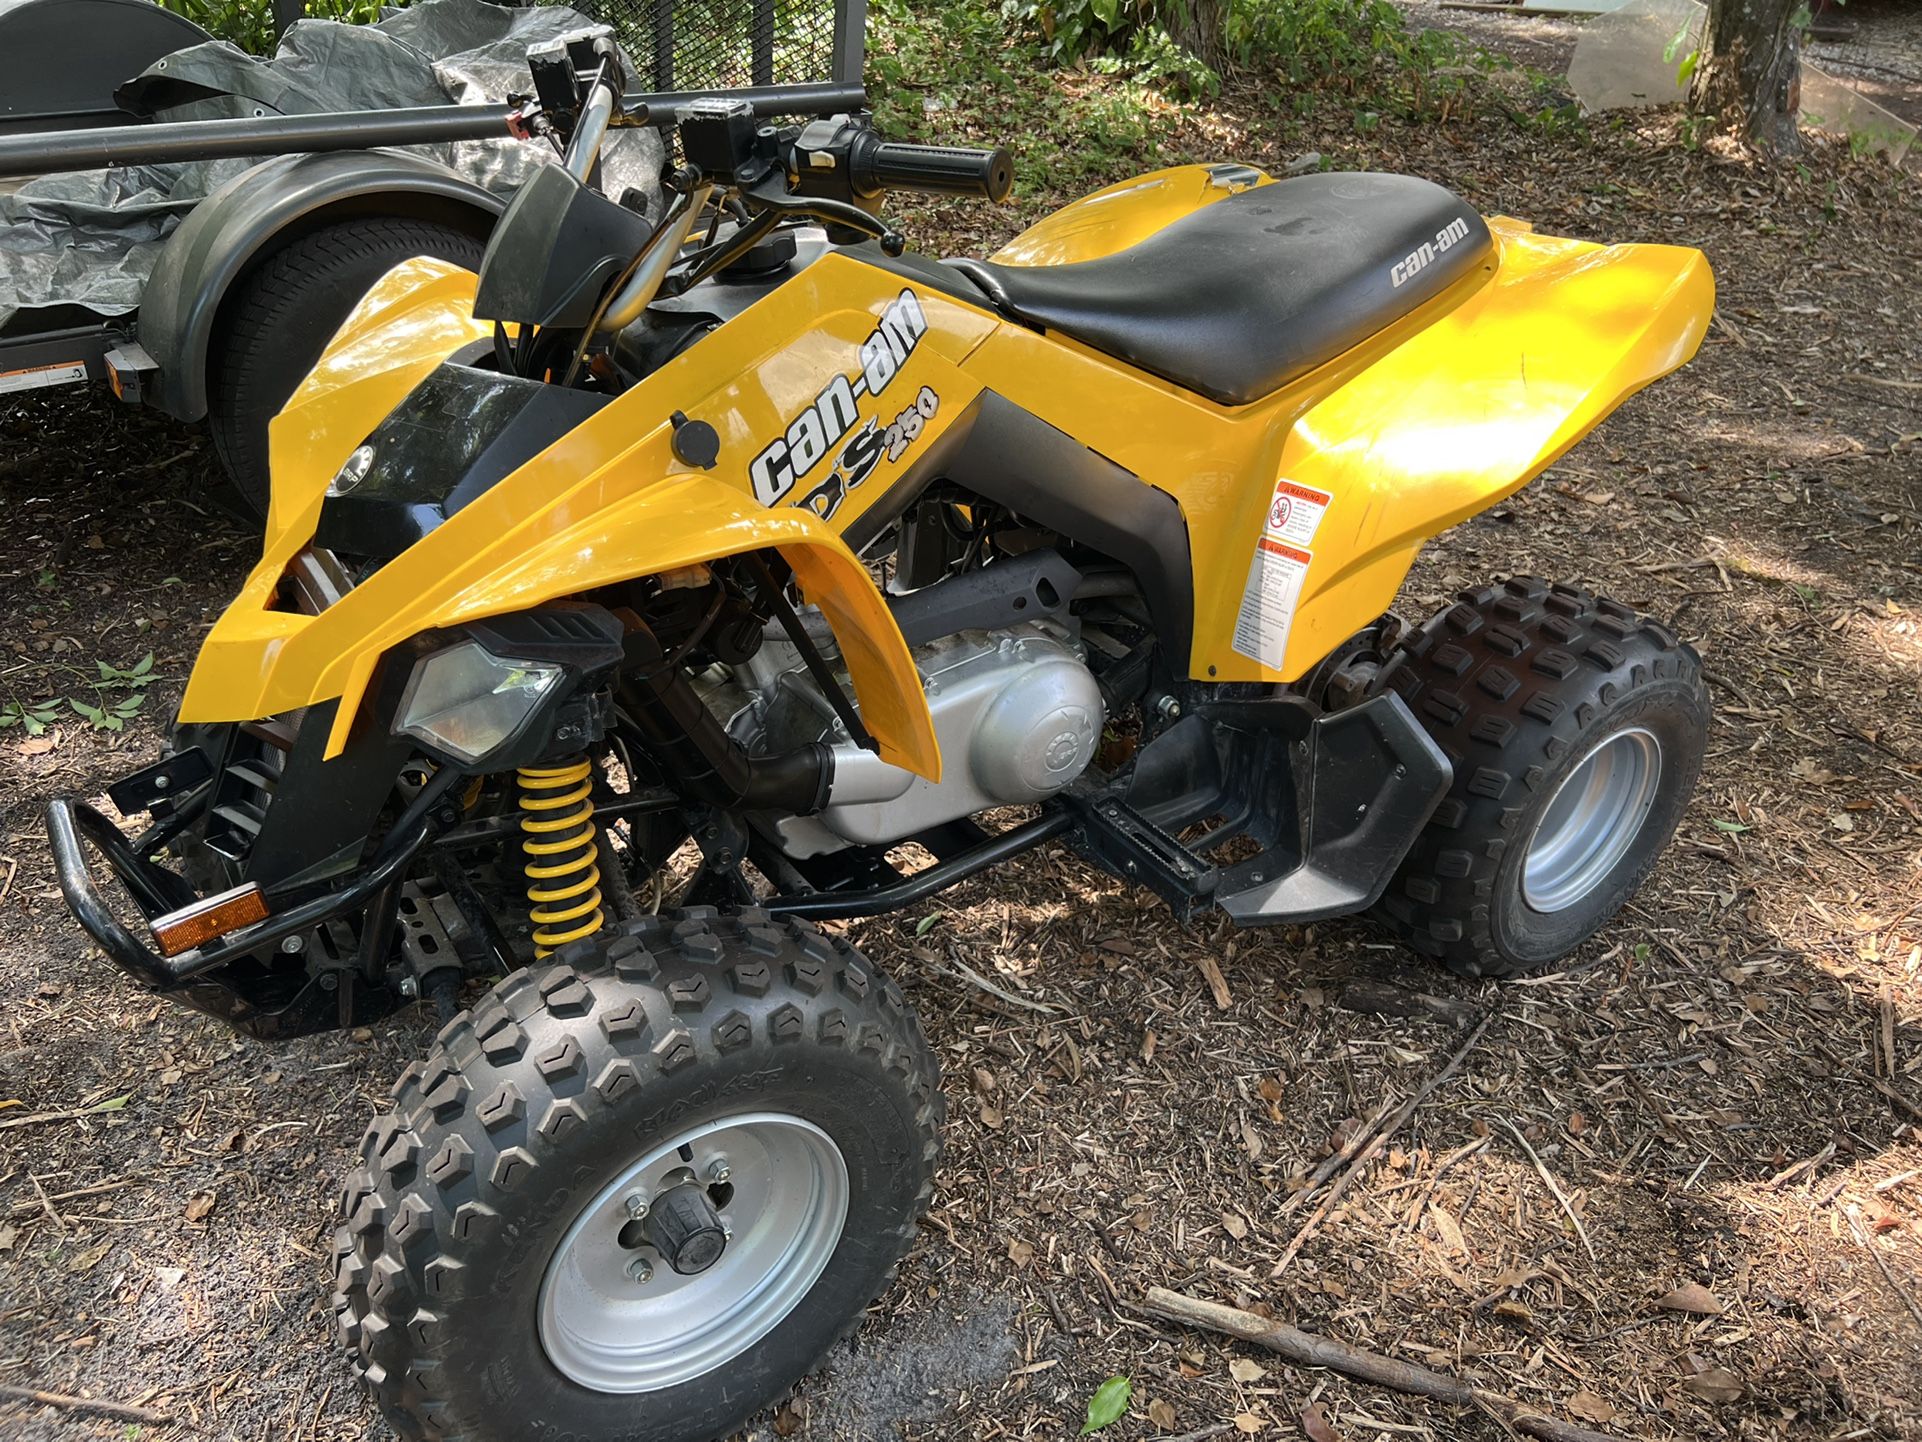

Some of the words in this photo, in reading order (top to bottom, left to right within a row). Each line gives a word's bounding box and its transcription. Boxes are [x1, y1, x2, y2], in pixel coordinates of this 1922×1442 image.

[1390, 217, 1469, 288] can-am
[750, 287, 928, 508] can-am
[883, 385, 940, 464] 250
[1290, 487, 1320, 501] WARNING
